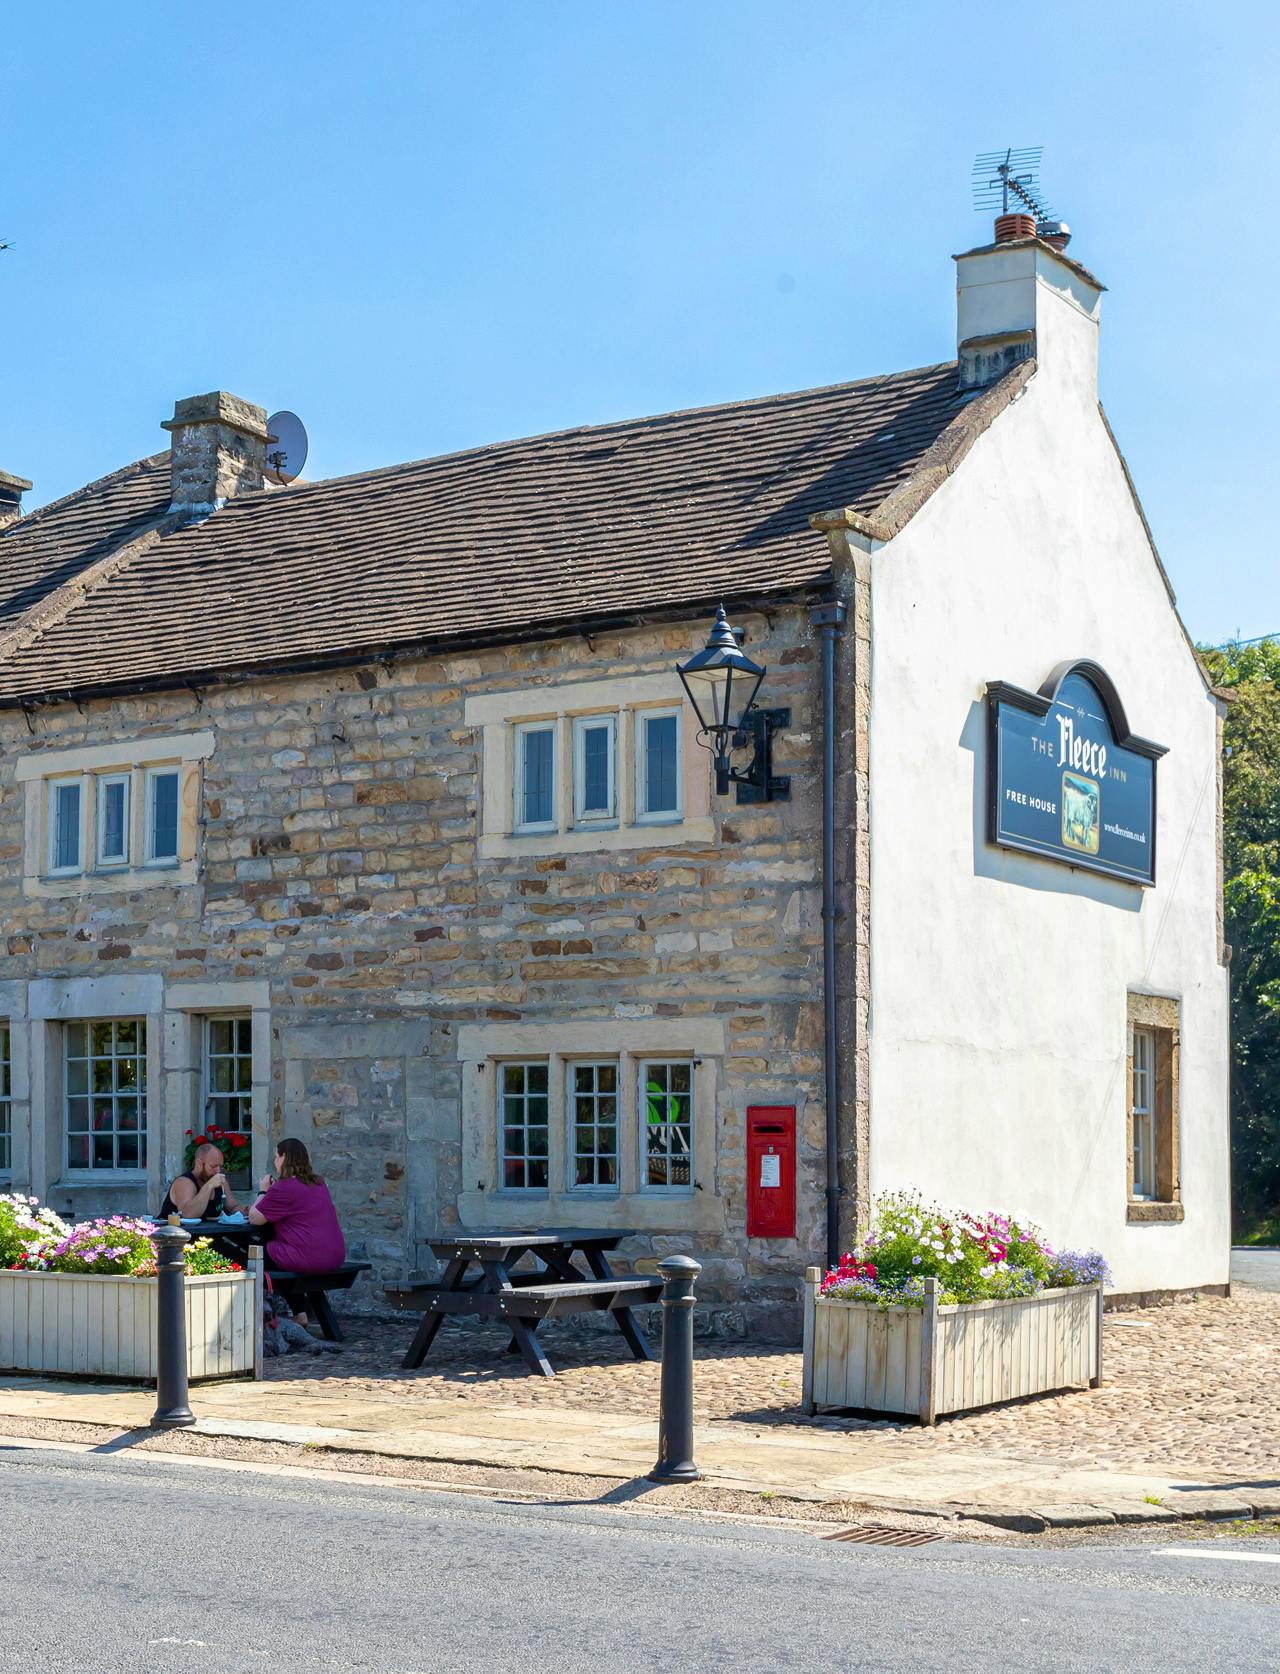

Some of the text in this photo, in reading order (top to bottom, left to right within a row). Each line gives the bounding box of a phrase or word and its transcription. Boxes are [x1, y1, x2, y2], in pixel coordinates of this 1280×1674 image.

[1032, 714, 1127, 783] THE Fleece INN
[1006, 789, 1057, 814] FREE HOUSE
